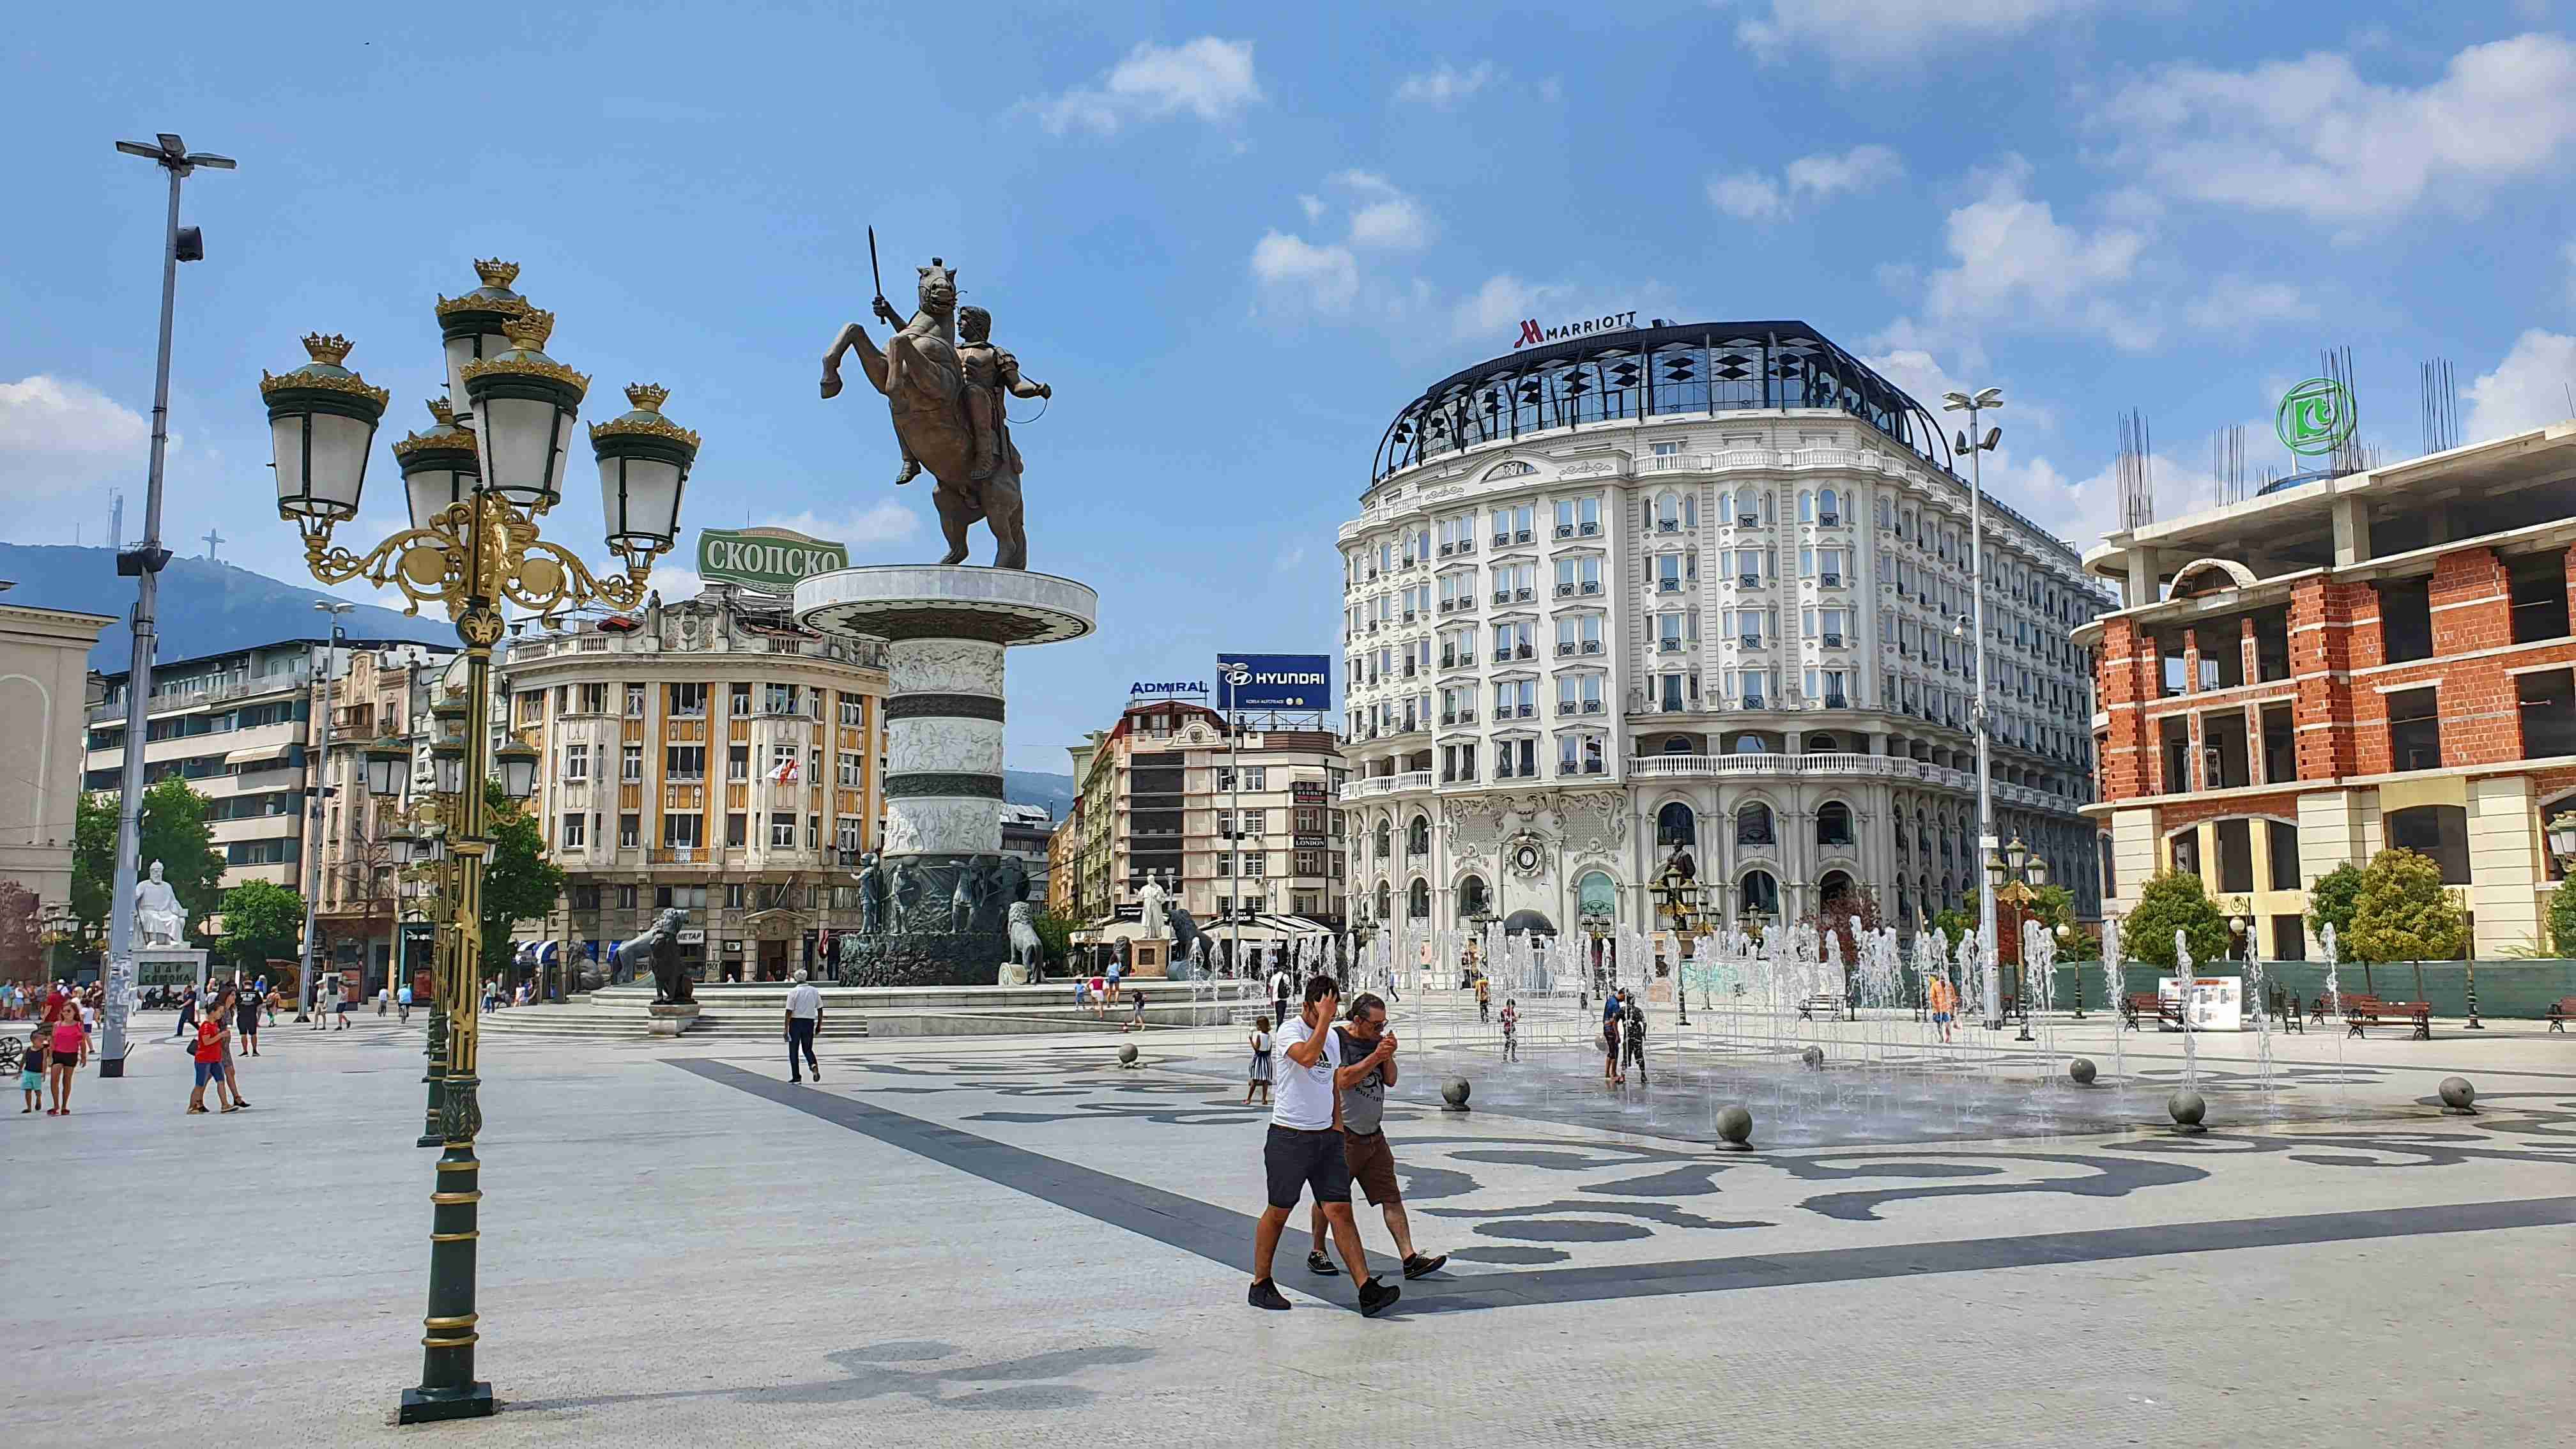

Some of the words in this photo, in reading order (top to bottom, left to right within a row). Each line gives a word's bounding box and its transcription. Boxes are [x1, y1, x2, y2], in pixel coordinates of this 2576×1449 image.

[1545, 310, 1637, 341] MARRIOTT
[707, 540, 841, 577] СКОПСКО
[1130, 680, 1210, 694] ADMIRAL
[1256, 673, 1324, 685] HYUNDAI
